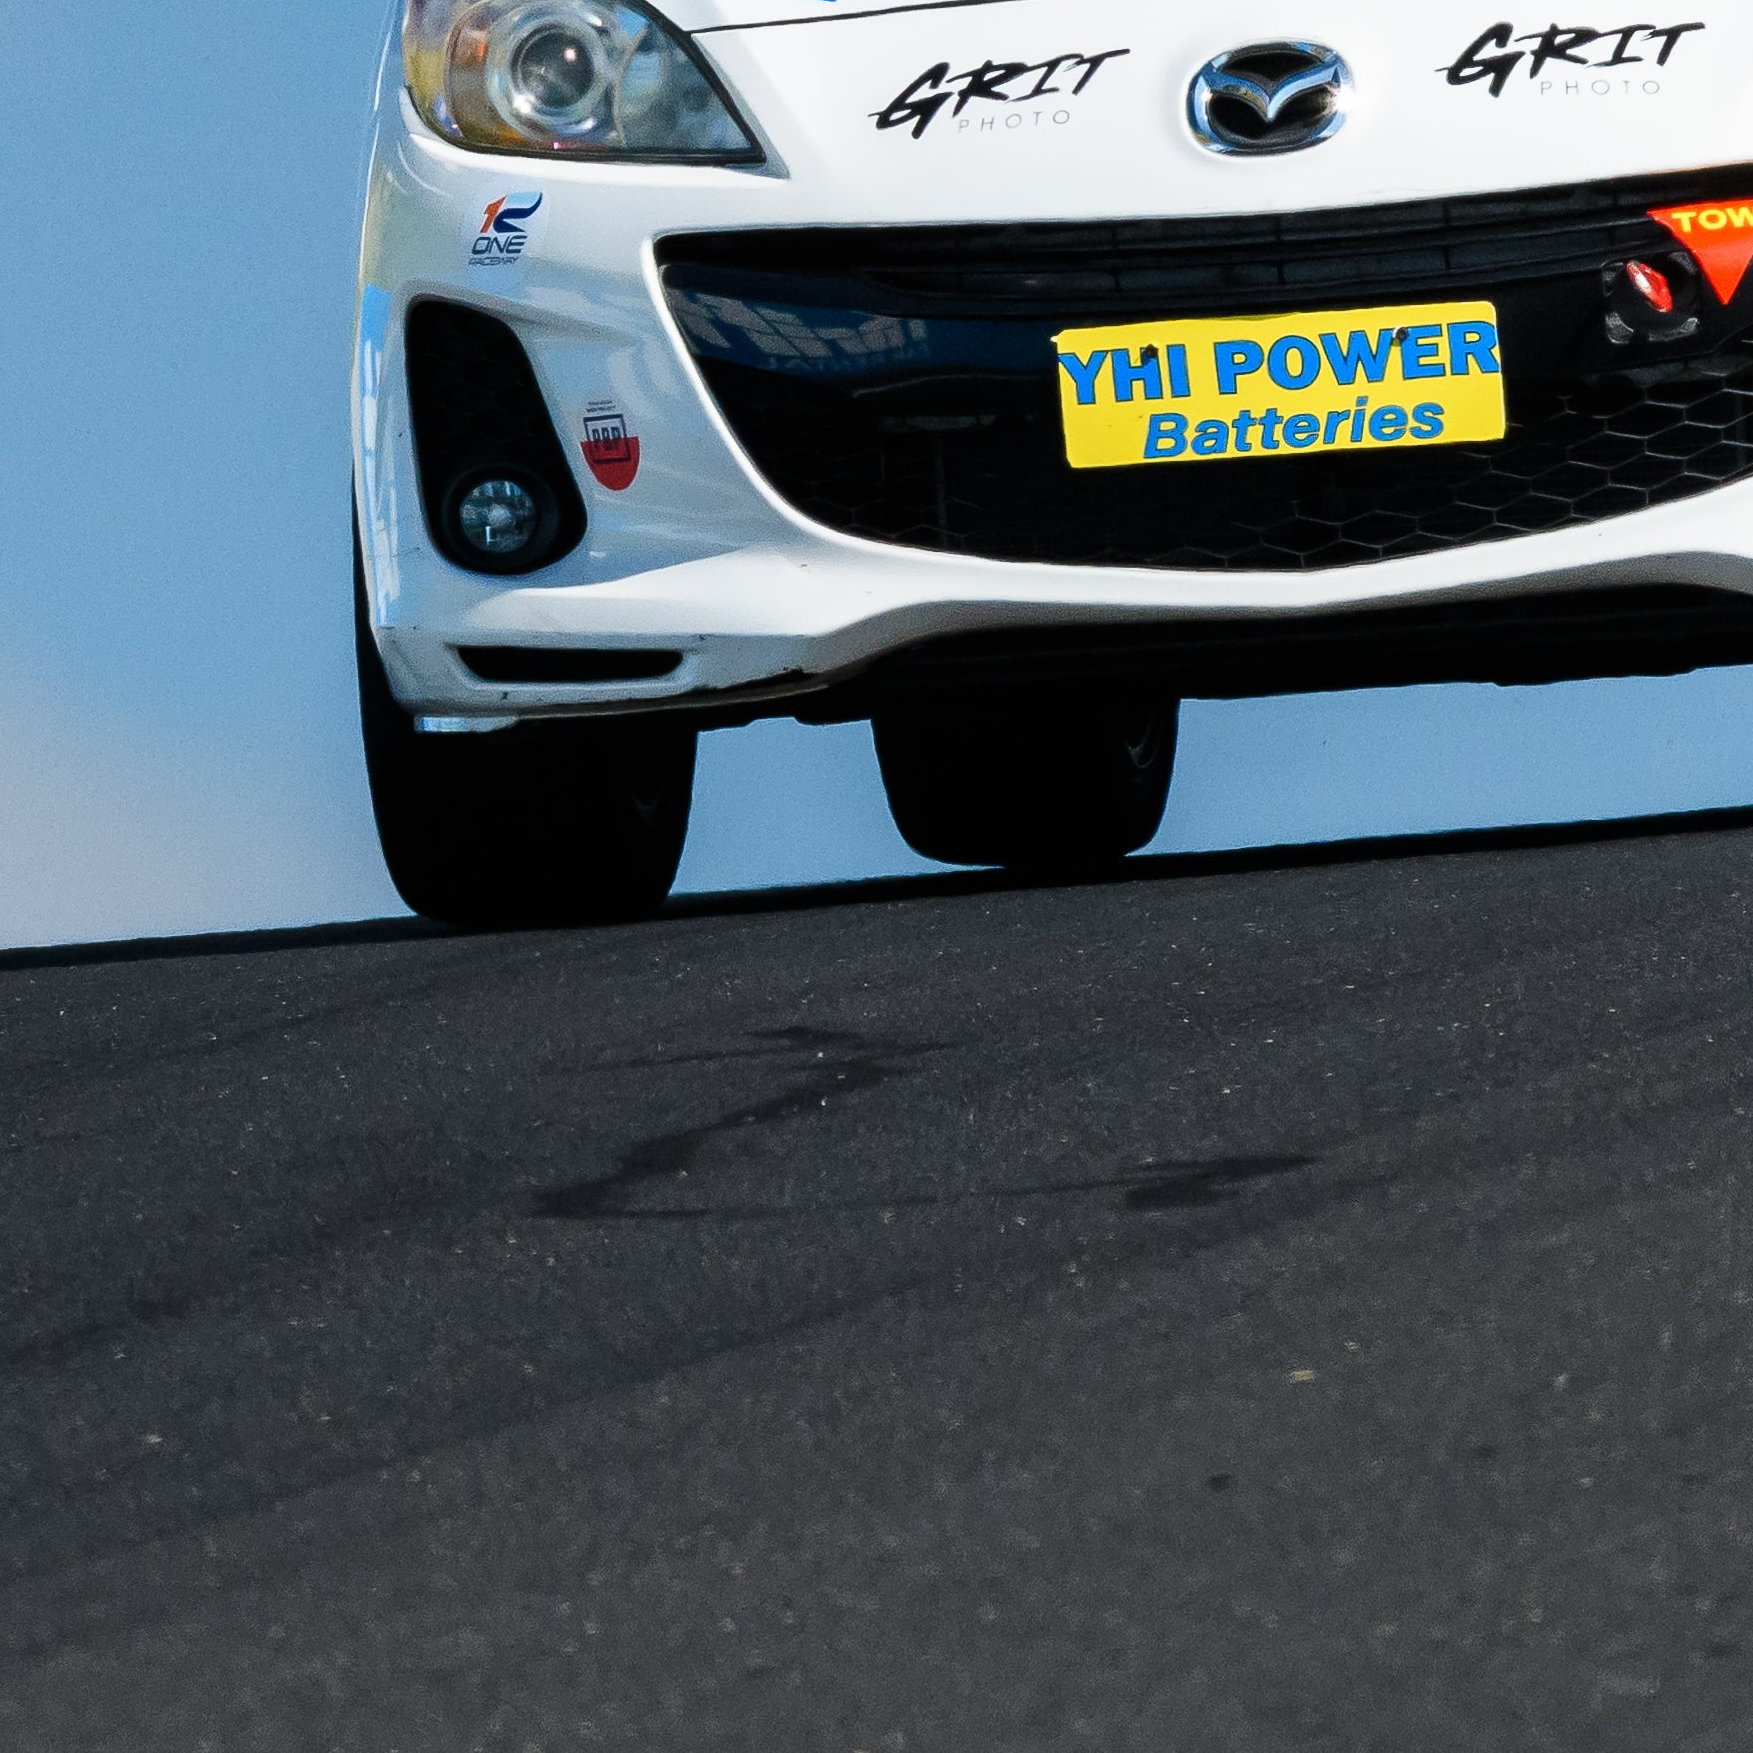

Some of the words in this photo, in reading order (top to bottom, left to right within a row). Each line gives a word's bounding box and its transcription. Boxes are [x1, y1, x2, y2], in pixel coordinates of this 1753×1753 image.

[1435, 21, 1706, 98] GRIT
[1540, 79, 1660, 96] PHOTO
[868, 48, 1131, 139] GRIT
[957, 110, 1071, 133] PHOTO
[471, 235, 528, 255] ONE
[1058, 344, 1191, 406] YHI
[1213, 320, 1501, 395] POWER
[1143, 396, 1445, 460] Batteries
